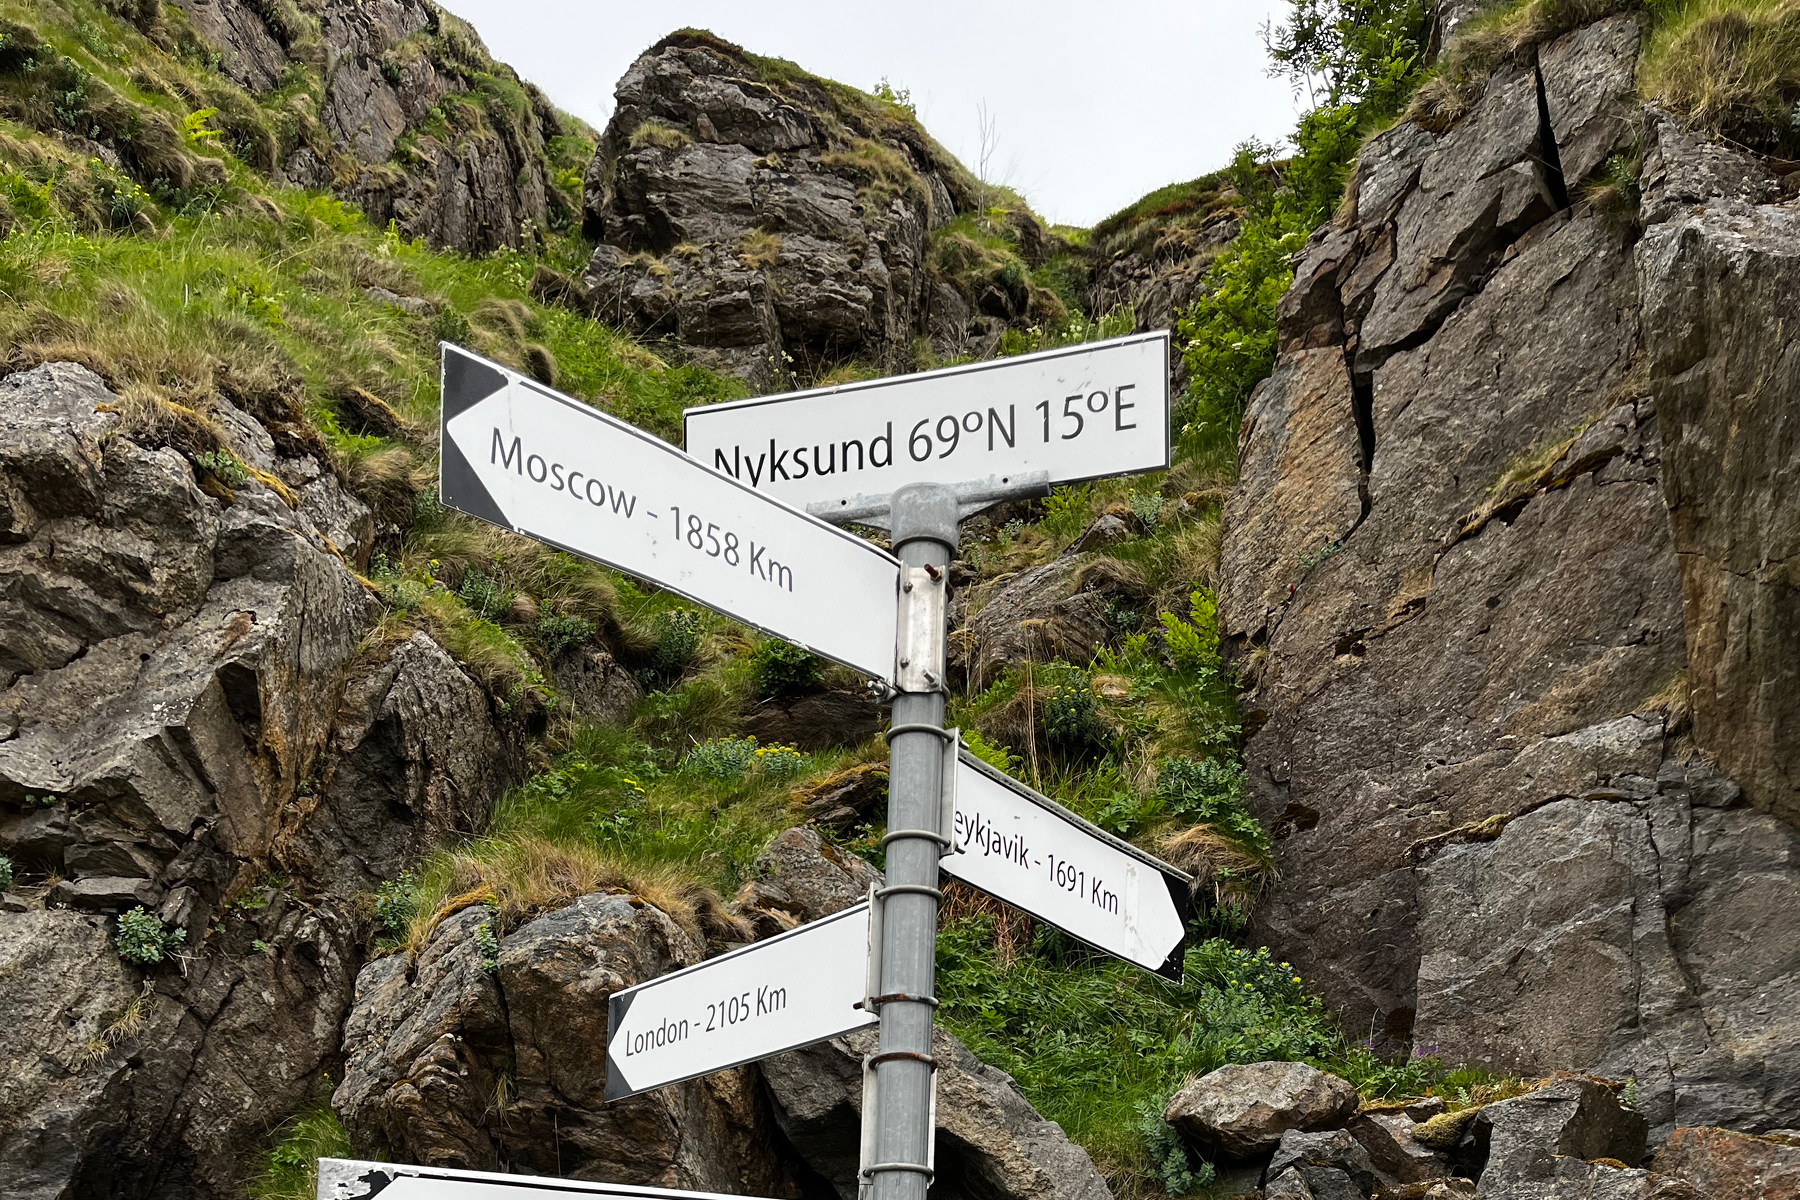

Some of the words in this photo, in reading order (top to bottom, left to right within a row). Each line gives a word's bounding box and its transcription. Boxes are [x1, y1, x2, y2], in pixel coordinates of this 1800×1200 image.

[714, 421, 894, 488] Nyksund
[490, 427, 637, 519] Moscow
[670, 506, 740, 567] 1858
[750, 541, 793, 593] Km
[954, 810, 1029, 870] eykjavik
[1048, 854, 1084, 898] 1691
[1091, 876, 1118, 915] Km
[625, 1017, 688, 1057] London
[705, 992, 750, 1033] 2105
[756, 985, 786, 1017] Km
